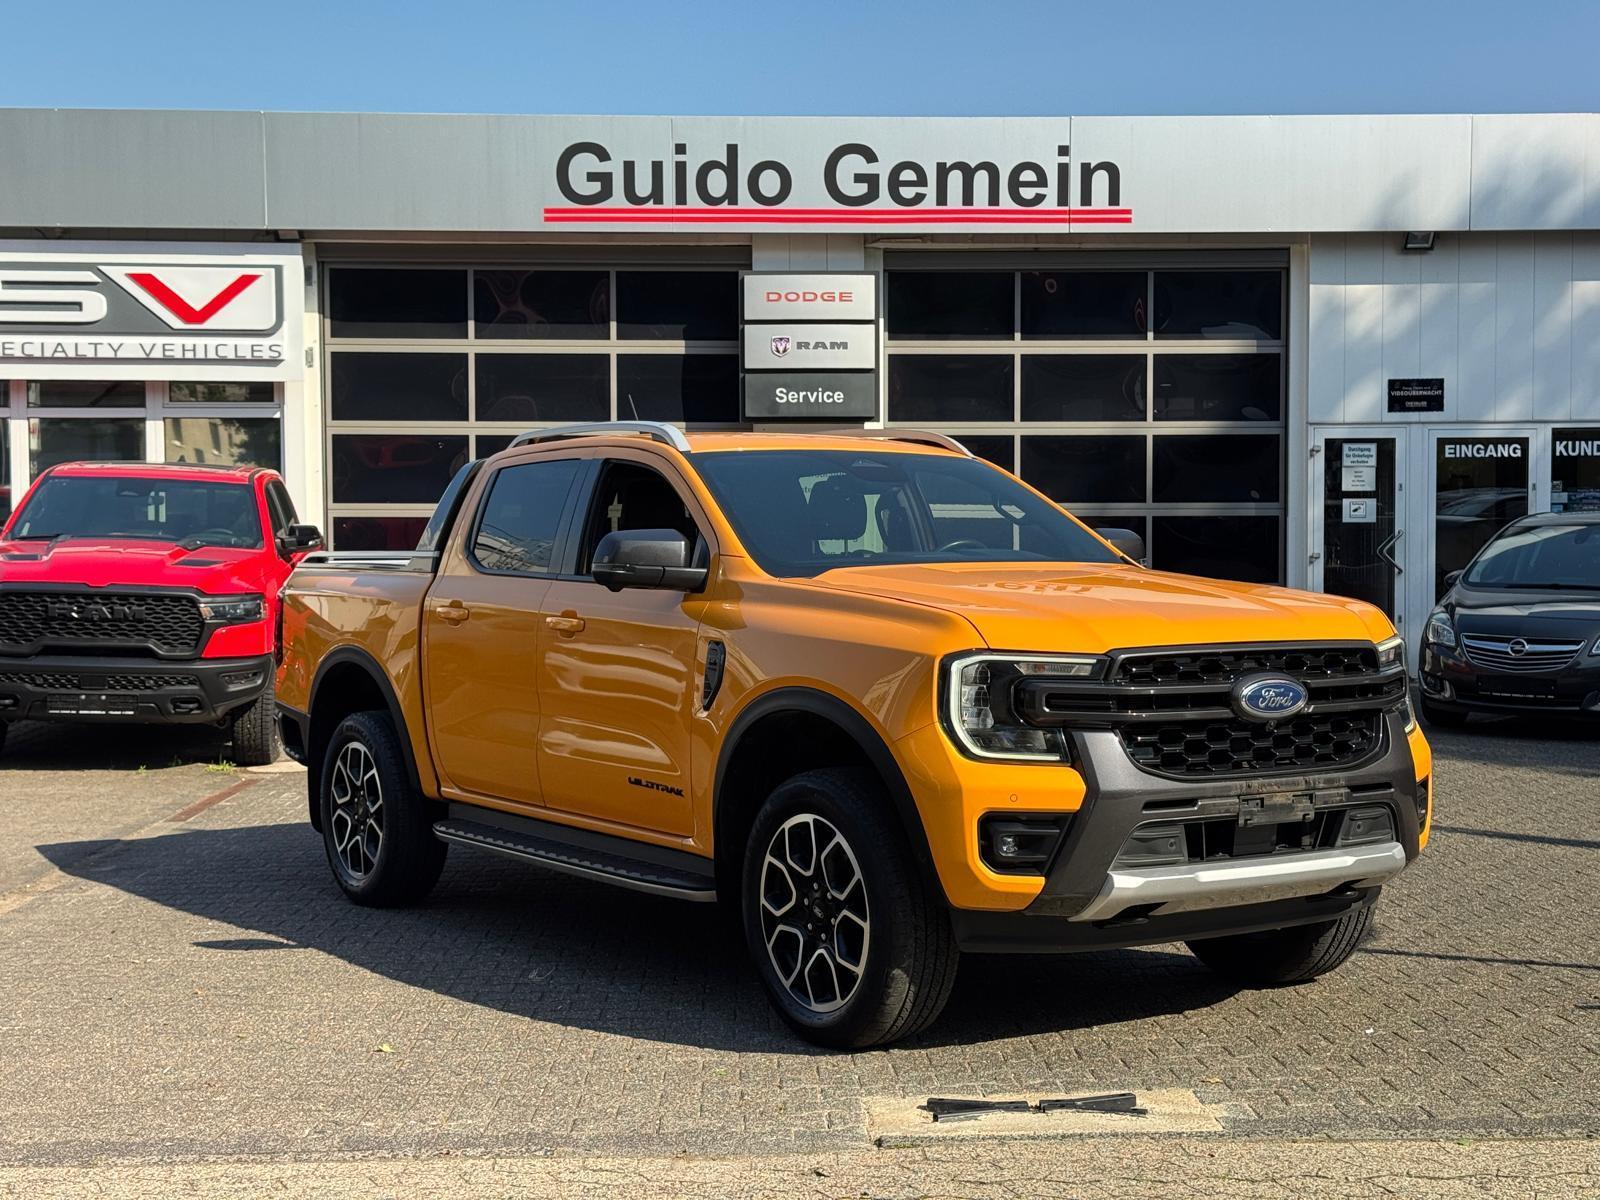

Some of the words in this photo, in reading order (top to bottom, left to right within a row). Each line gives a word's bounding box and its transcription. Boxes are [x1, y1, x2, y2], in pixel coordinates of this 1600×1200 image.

[555, 141, 793, 207] Guido
[822, 143, 1122, 208] Gemein
[766, 291, 854, 302] DODGE
[1, 342, 124, 358] ECIALTY
[139, 343, 282, 360] VEHICLES
[796, 341, 849, 350] RAM
[775, 387, 845, 404] Service
[1444, 443, 1522, 459] EINGANG
[1555, 440, 1600, 456] KUND
[1258, 687, 1294, 707] Ford
